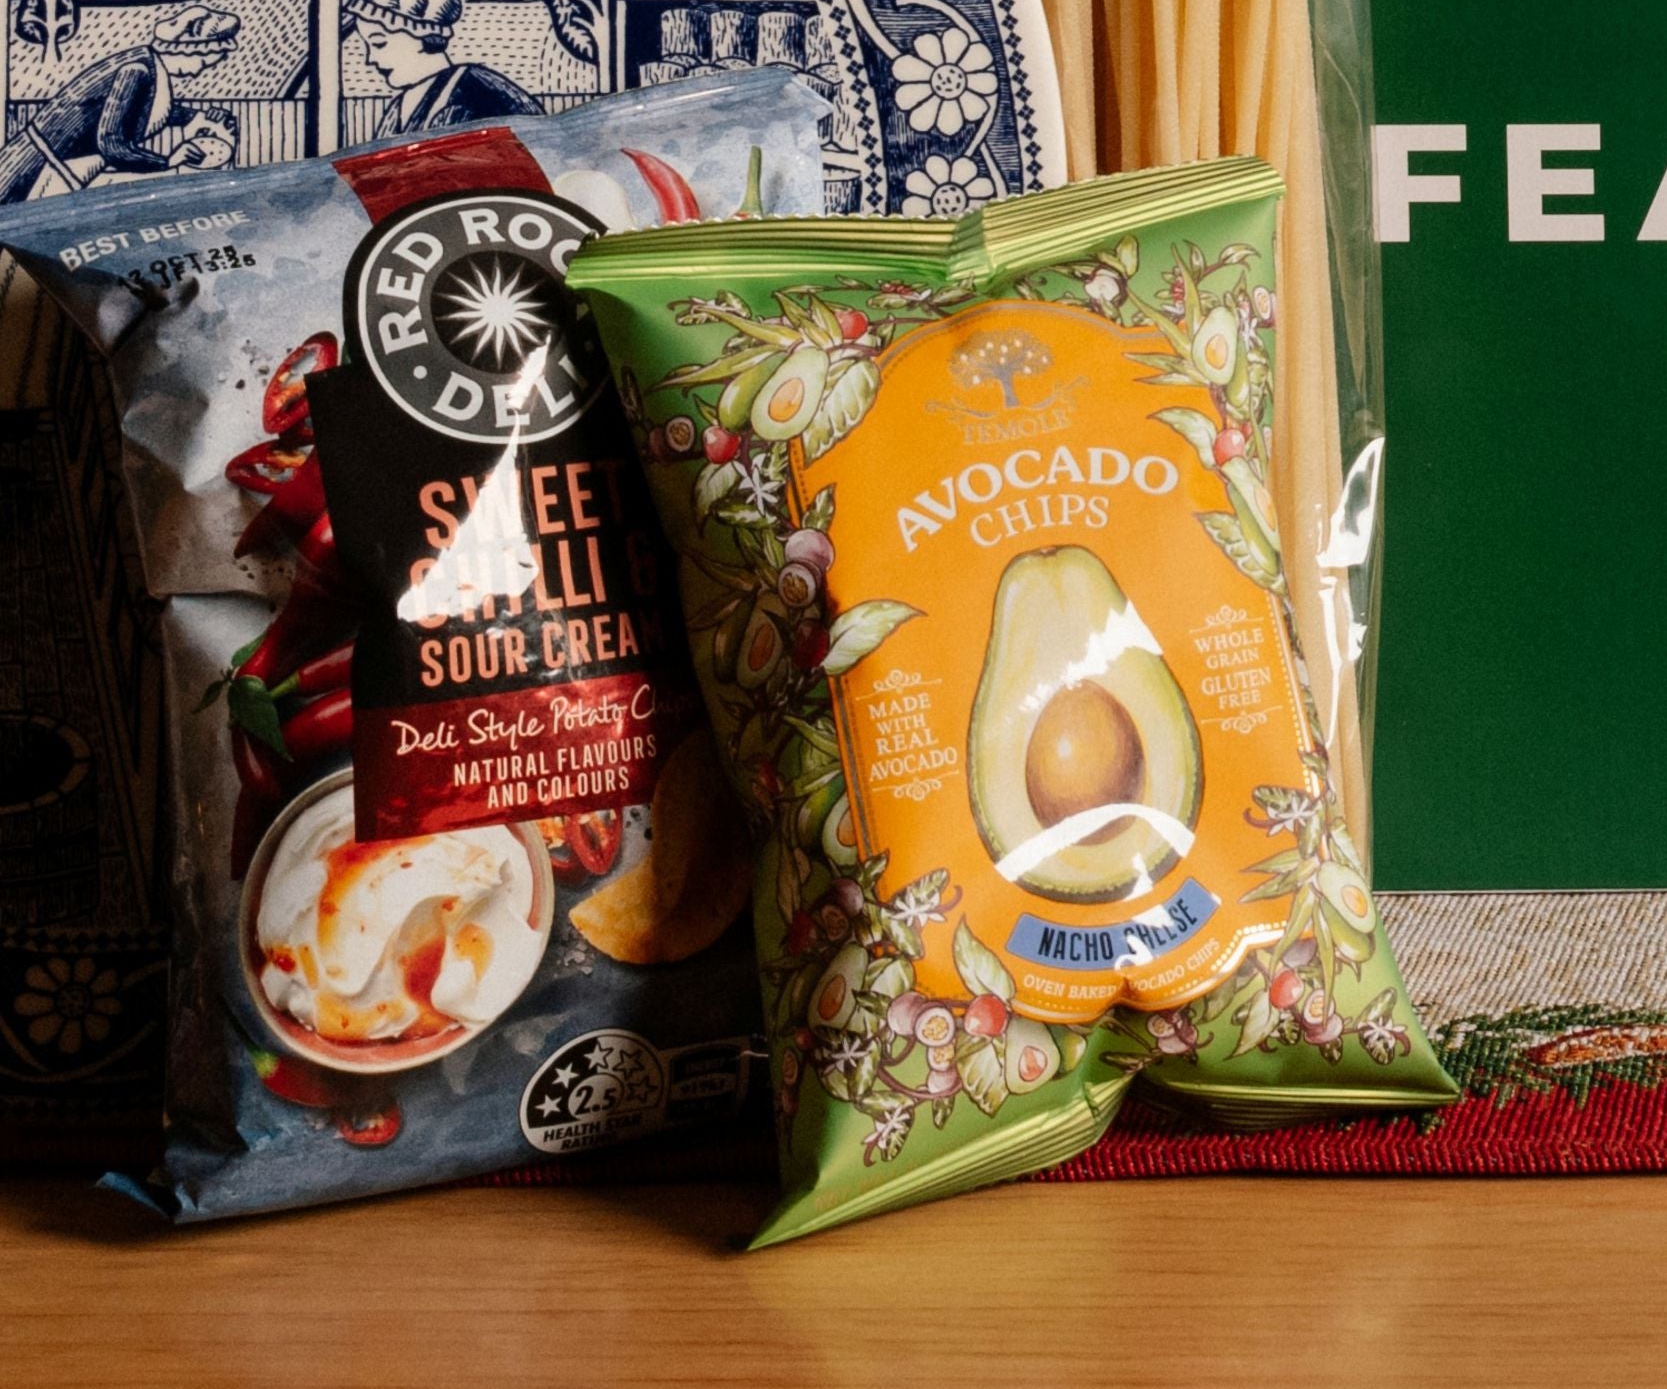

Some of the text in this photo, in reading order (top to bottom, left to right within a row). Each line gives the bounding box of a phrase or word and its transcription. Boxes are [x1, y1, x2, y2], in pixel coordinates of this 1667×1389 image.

[59, 210, 251, 272] BEST BEFORE
[375, 207, 585, 356] RED ROC
[896, 445, 1180, 553] AVOCADO
[968, 494, 1110, 548] CHIPS
[419, 611, 645, 689] SOUR CREA
[1194, 627, 1265, 653] WHOLE
[1205, 647, 1260, 670] GRAIN
[1200, 666, 1272, 696] GLUTEN
[1218, 689, 1262, 710] FREE
[868, 693, 931, 720] MADE
[390, 719, 461, 756] Deli
[466, 707, 546, 751] Style
[549, 695, 629, 735] Potato
[875, 714, 926, 737] WITH
[875, 728, 940, 755] REAL
[453, 733, 658, 787] NATURAL FLAVOURS
[869, 746, 959, 782] AVOCADO
[488, 766, 631, 808] AND COLOURS
[1037, 925, 1115, 962] NACHO
